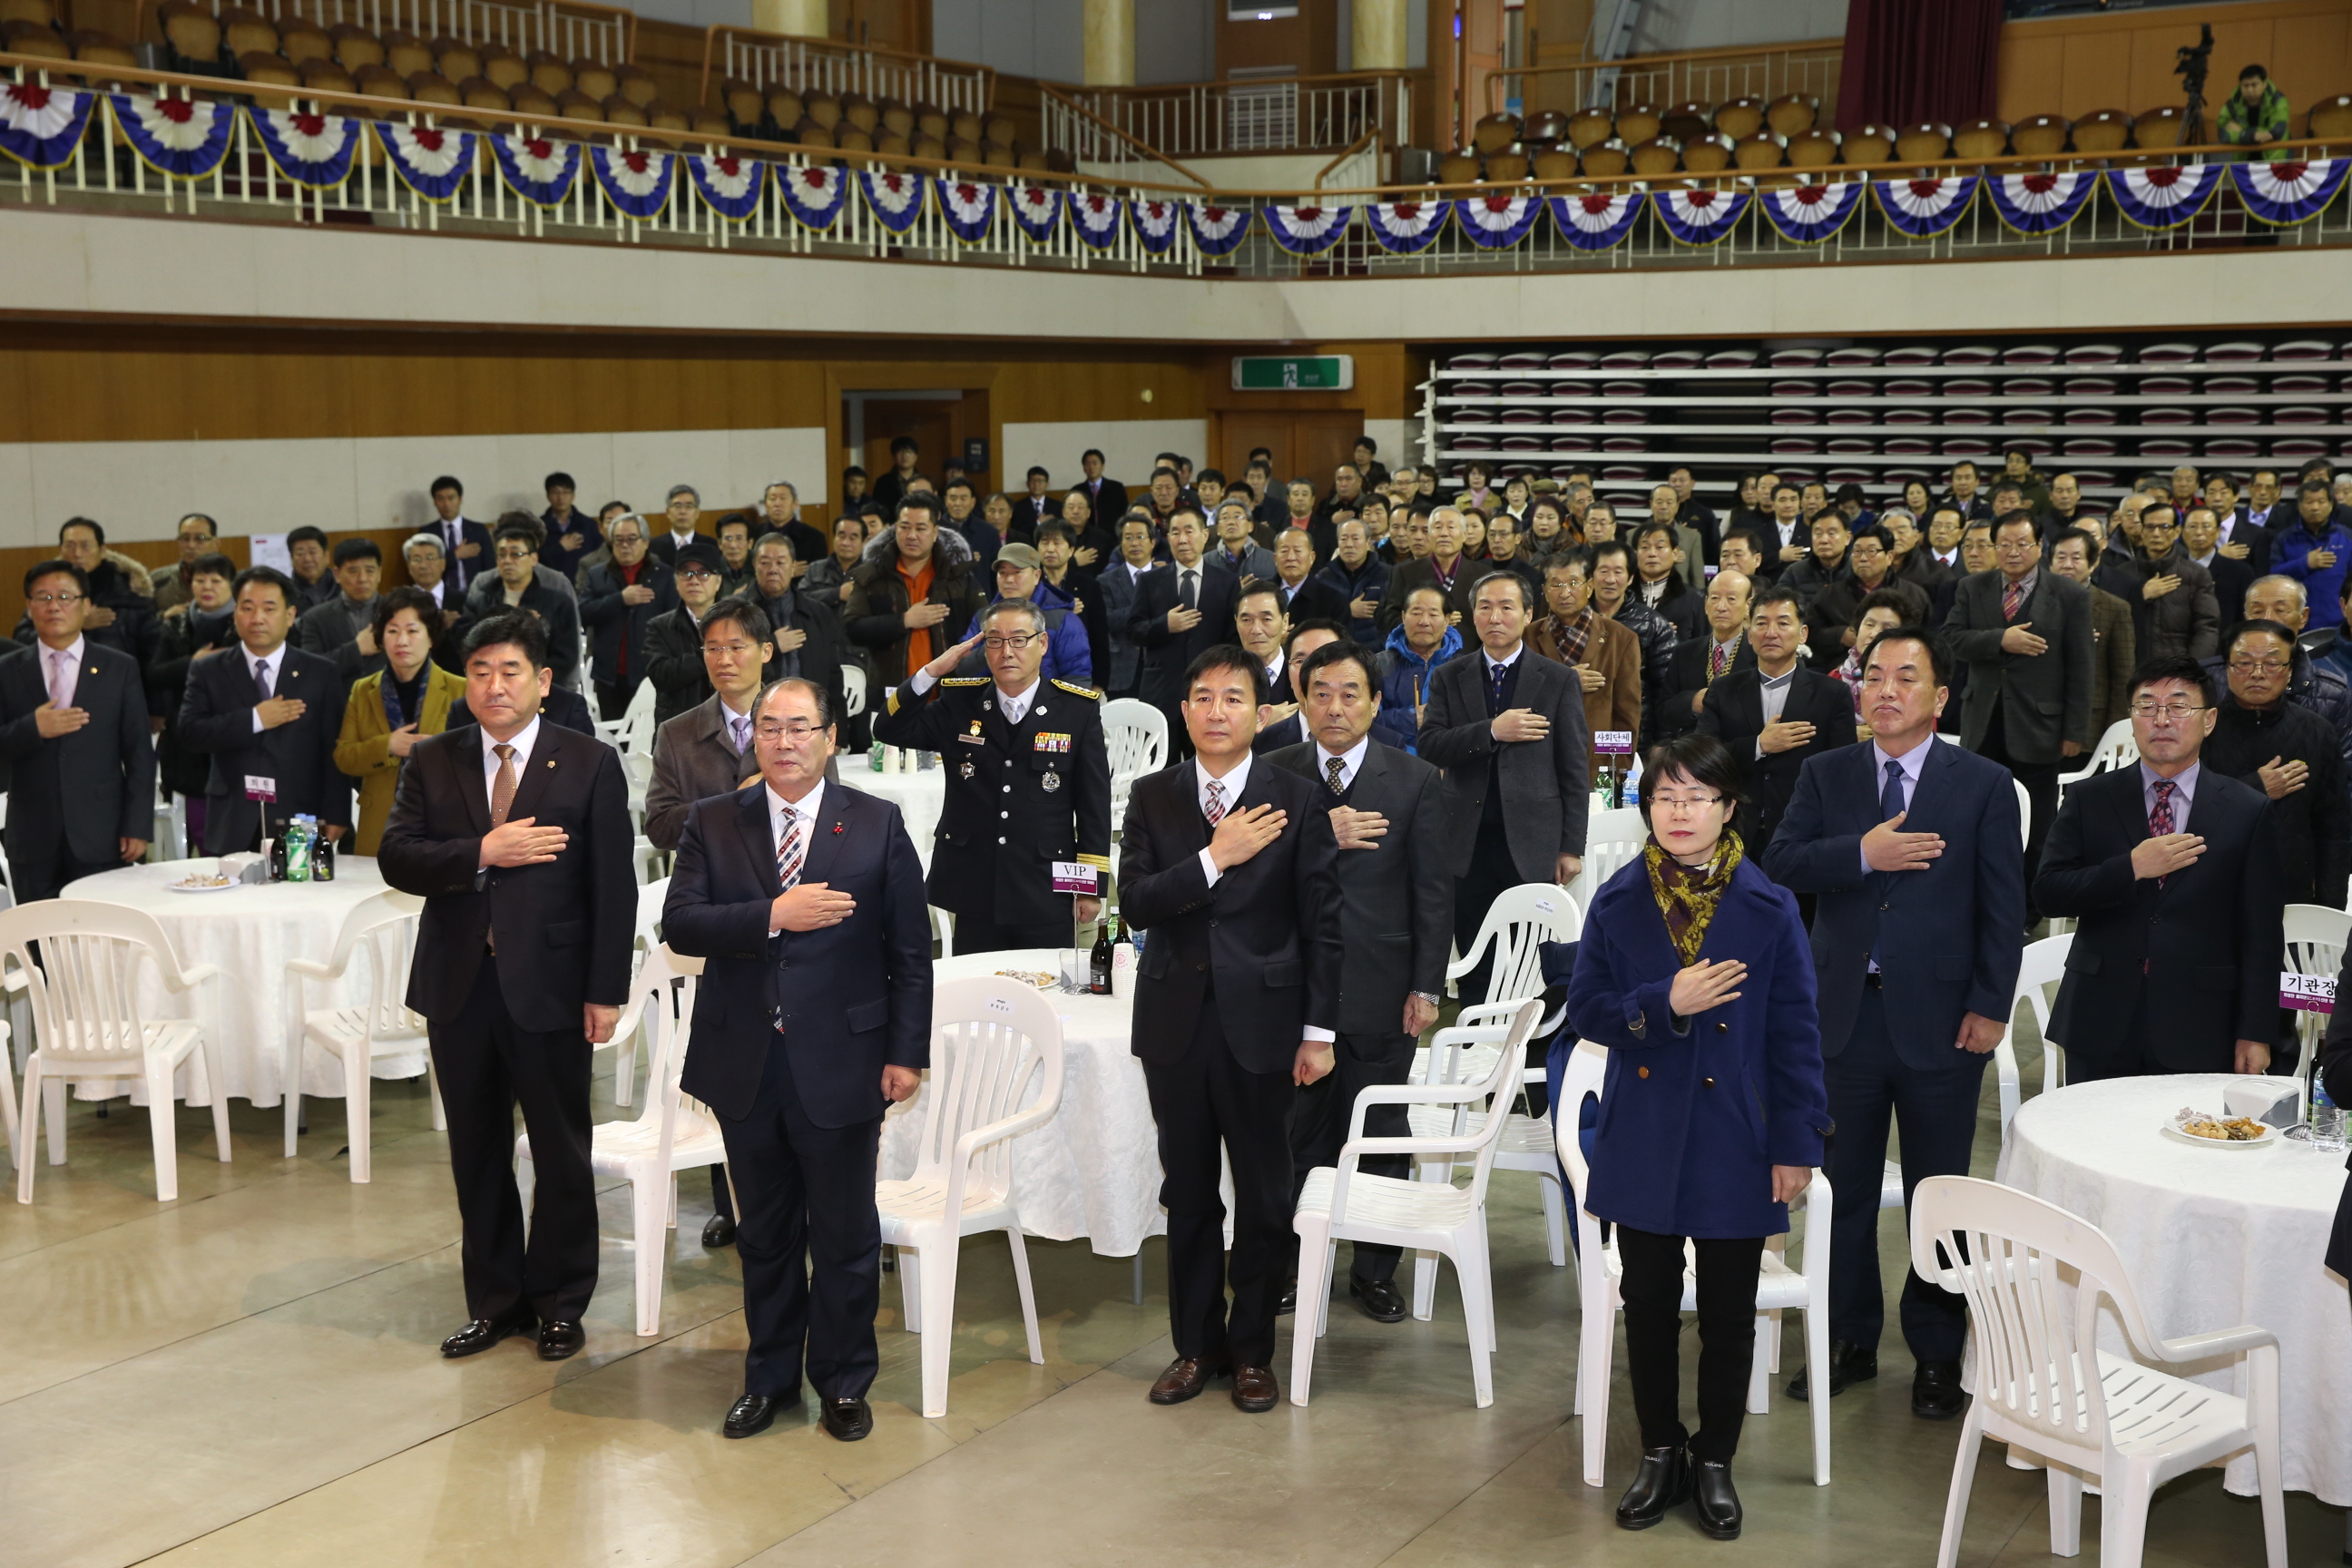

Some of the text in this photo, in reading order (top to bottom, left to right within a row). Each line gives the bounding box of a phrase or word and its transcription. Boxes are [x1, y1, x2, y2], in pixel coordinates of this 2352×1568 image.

[1596, 732, 1630, 742] 사회단체
[1063, 865, 1086, 877] VIP
[2288, 975, 2336, 996] 기관장
